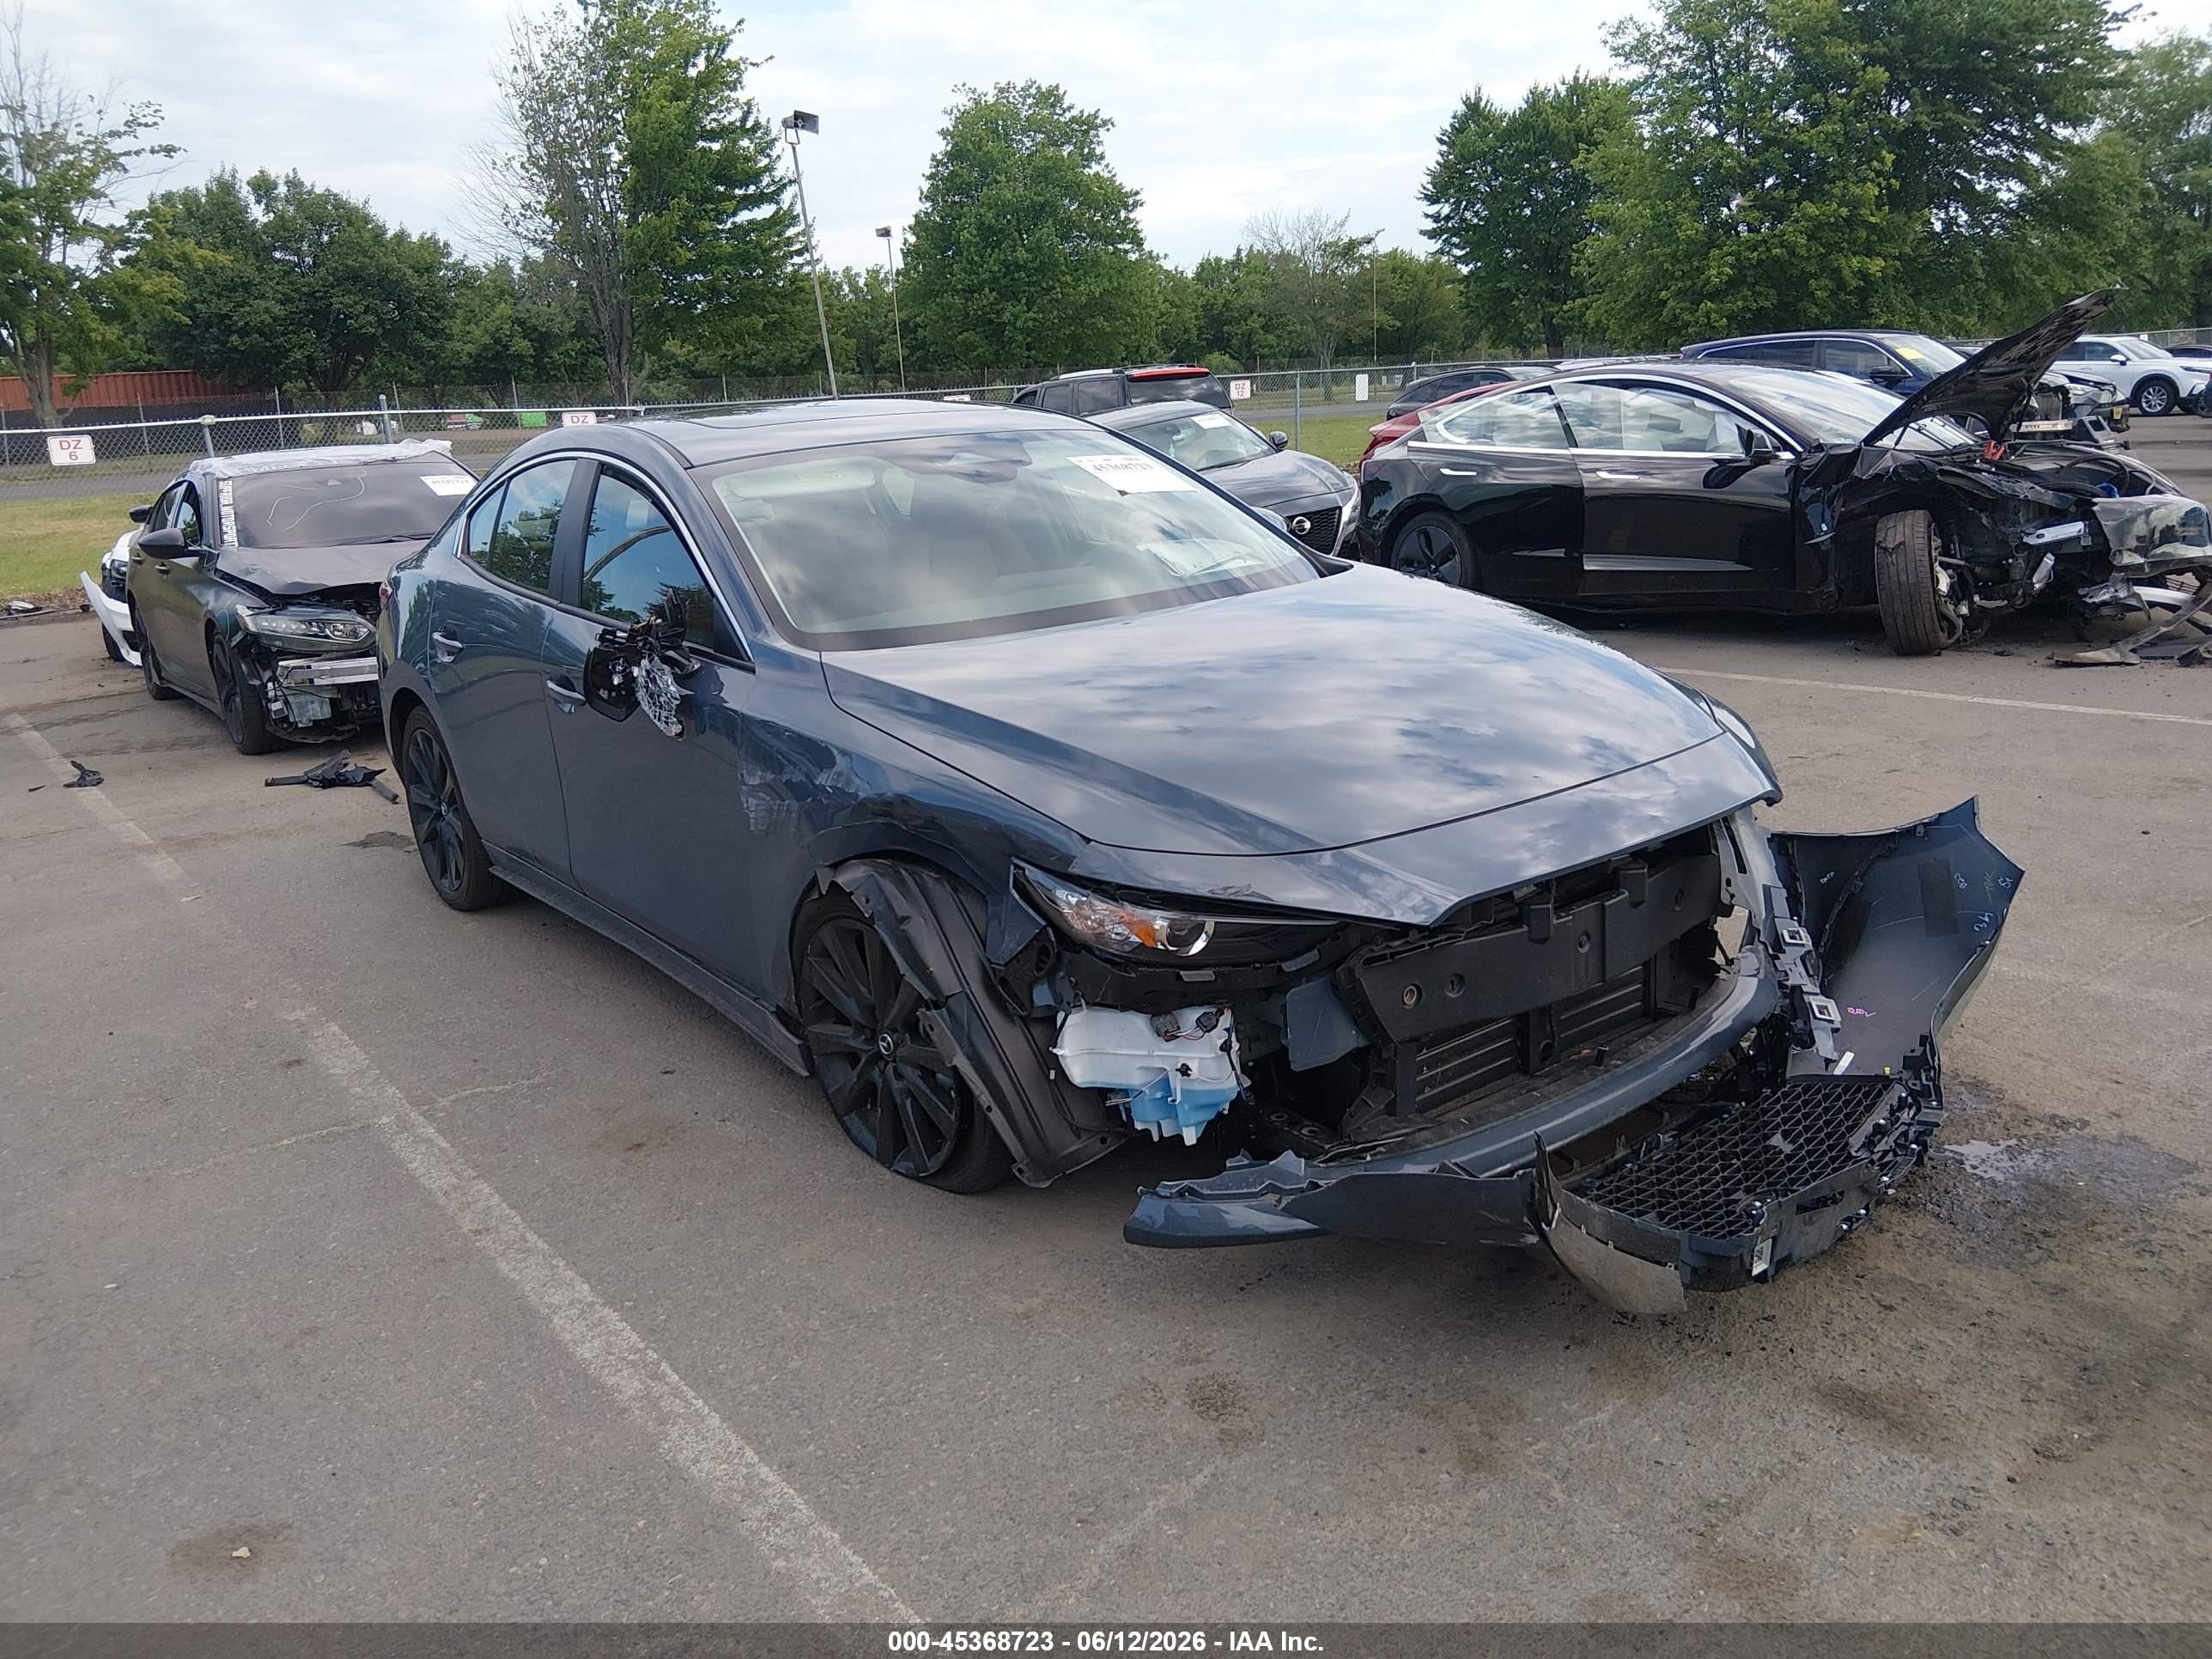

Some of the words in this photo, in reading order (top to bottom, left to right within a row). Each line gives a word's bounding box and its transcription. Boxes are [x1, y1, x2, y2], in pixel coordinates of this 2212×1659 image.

[570, 415, 589, 424] DZ
[59, 439, 83, 451] DZ
[69, 451, 79, 461] 6
